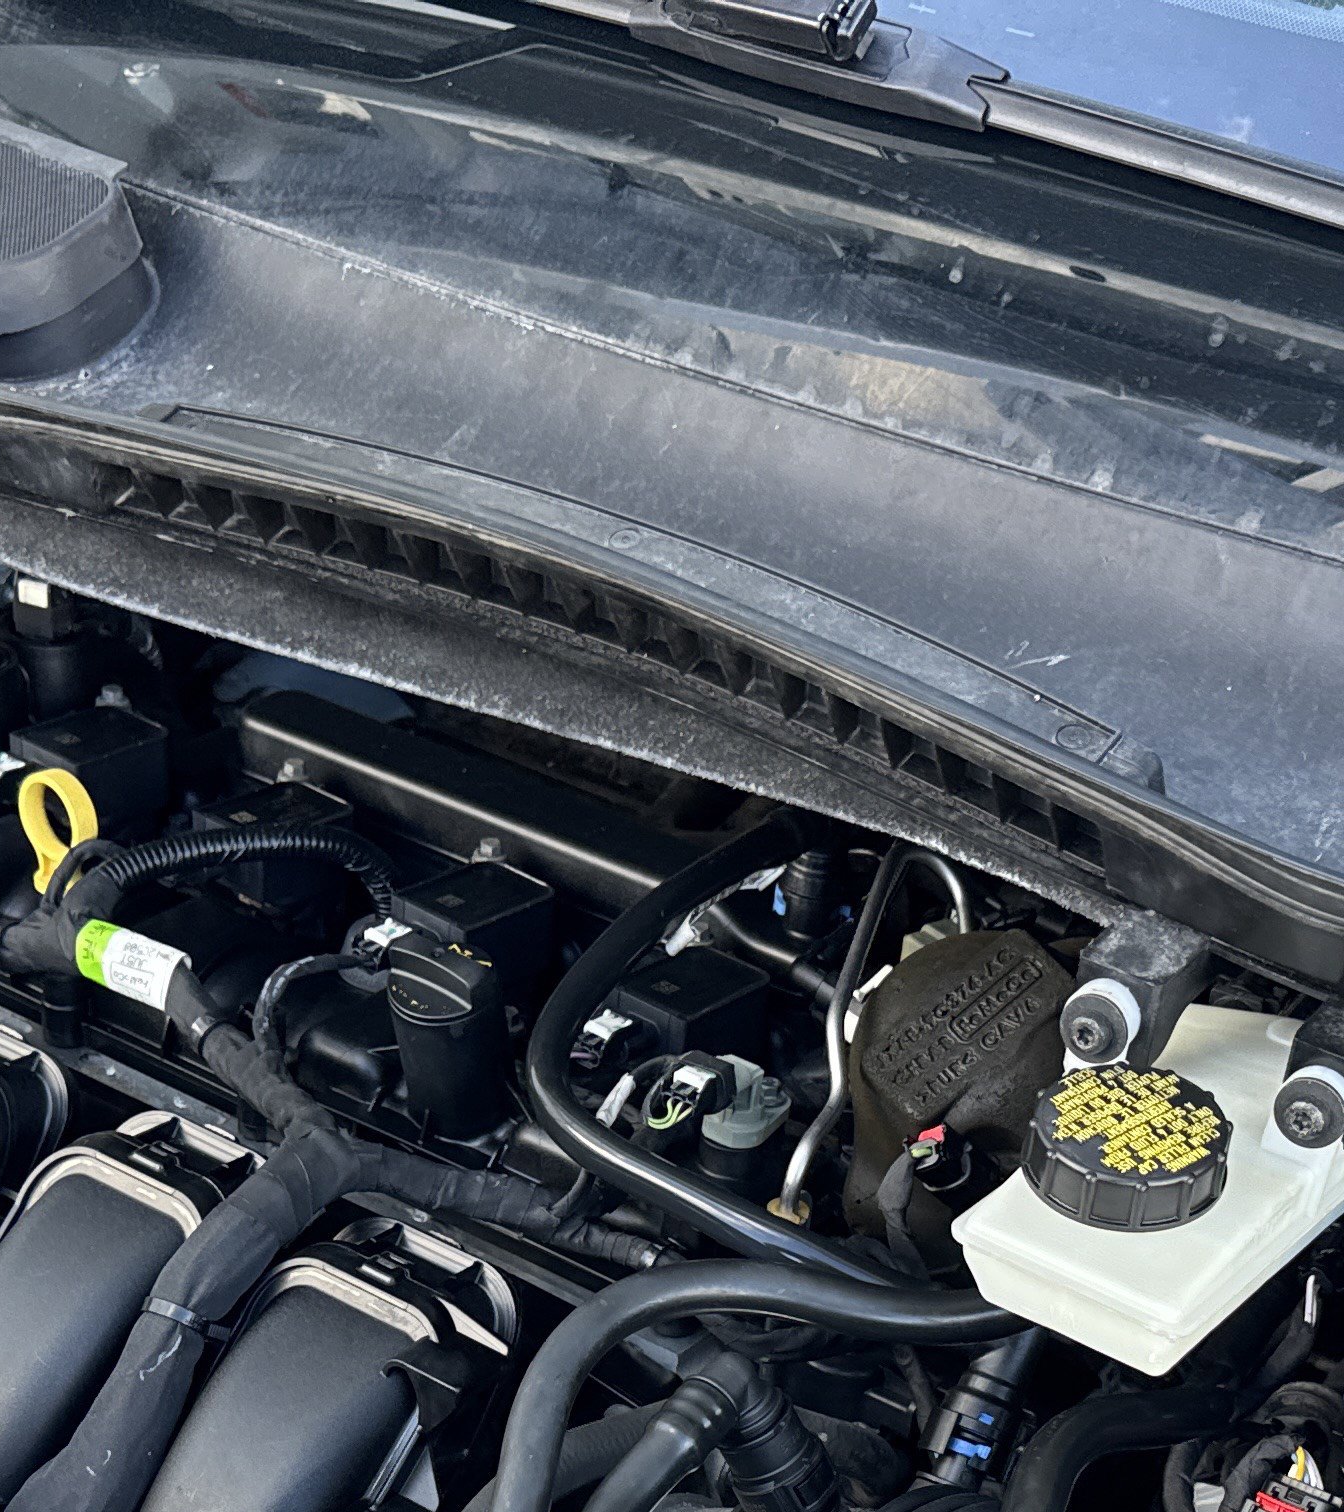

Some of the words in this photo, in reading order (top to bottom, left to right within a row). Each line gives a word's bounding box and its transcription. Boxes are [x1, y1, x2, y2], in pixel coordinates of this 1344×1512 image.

[1116, 1068, 1138, 1083] DOT
[1122, 1069, 1160, 1092] PLOYER
[1147, 1071, 1180, 1092] AVANT
[1048, 1074, 1103, 1106] CONTENANT
[1054, 1082, 1109, 1114] PROVENANT
[1100, 1085, 1126, 1103] QUE
[1118, 1093, 1137, 1107] LE
[1131, 1083, 1180, 1112] NETTOYER
[1132, 1085, 1151, 1100] DE
[1087, 1095, 1106, 1110] DU
[1115, 1105, 1135, 1120] LE
[1050, 1103, 1091, 1129] LIQUIDE
[1148, 1105, 1187, 1129] SEALED
[1186, 1104, 1213, 1123] ONLY
[1070, 1114, 1118, 1143] BOUCHON
[1165, 1116, 1189, 1133] DOT
[1182, 1113, 1221, 1138] BEFORE
[1127, 1131, 1160, 1152] FLUID
[1187, 1126, 1221, 1148] CLEAN
[1098, 1146, 1132, 1168] FROM
[1154, 1141, 1191, 1165] FILLER
[1111, 1156, 1137, 1174] USE
[1134, 1158, 1159, 1175] CAP
